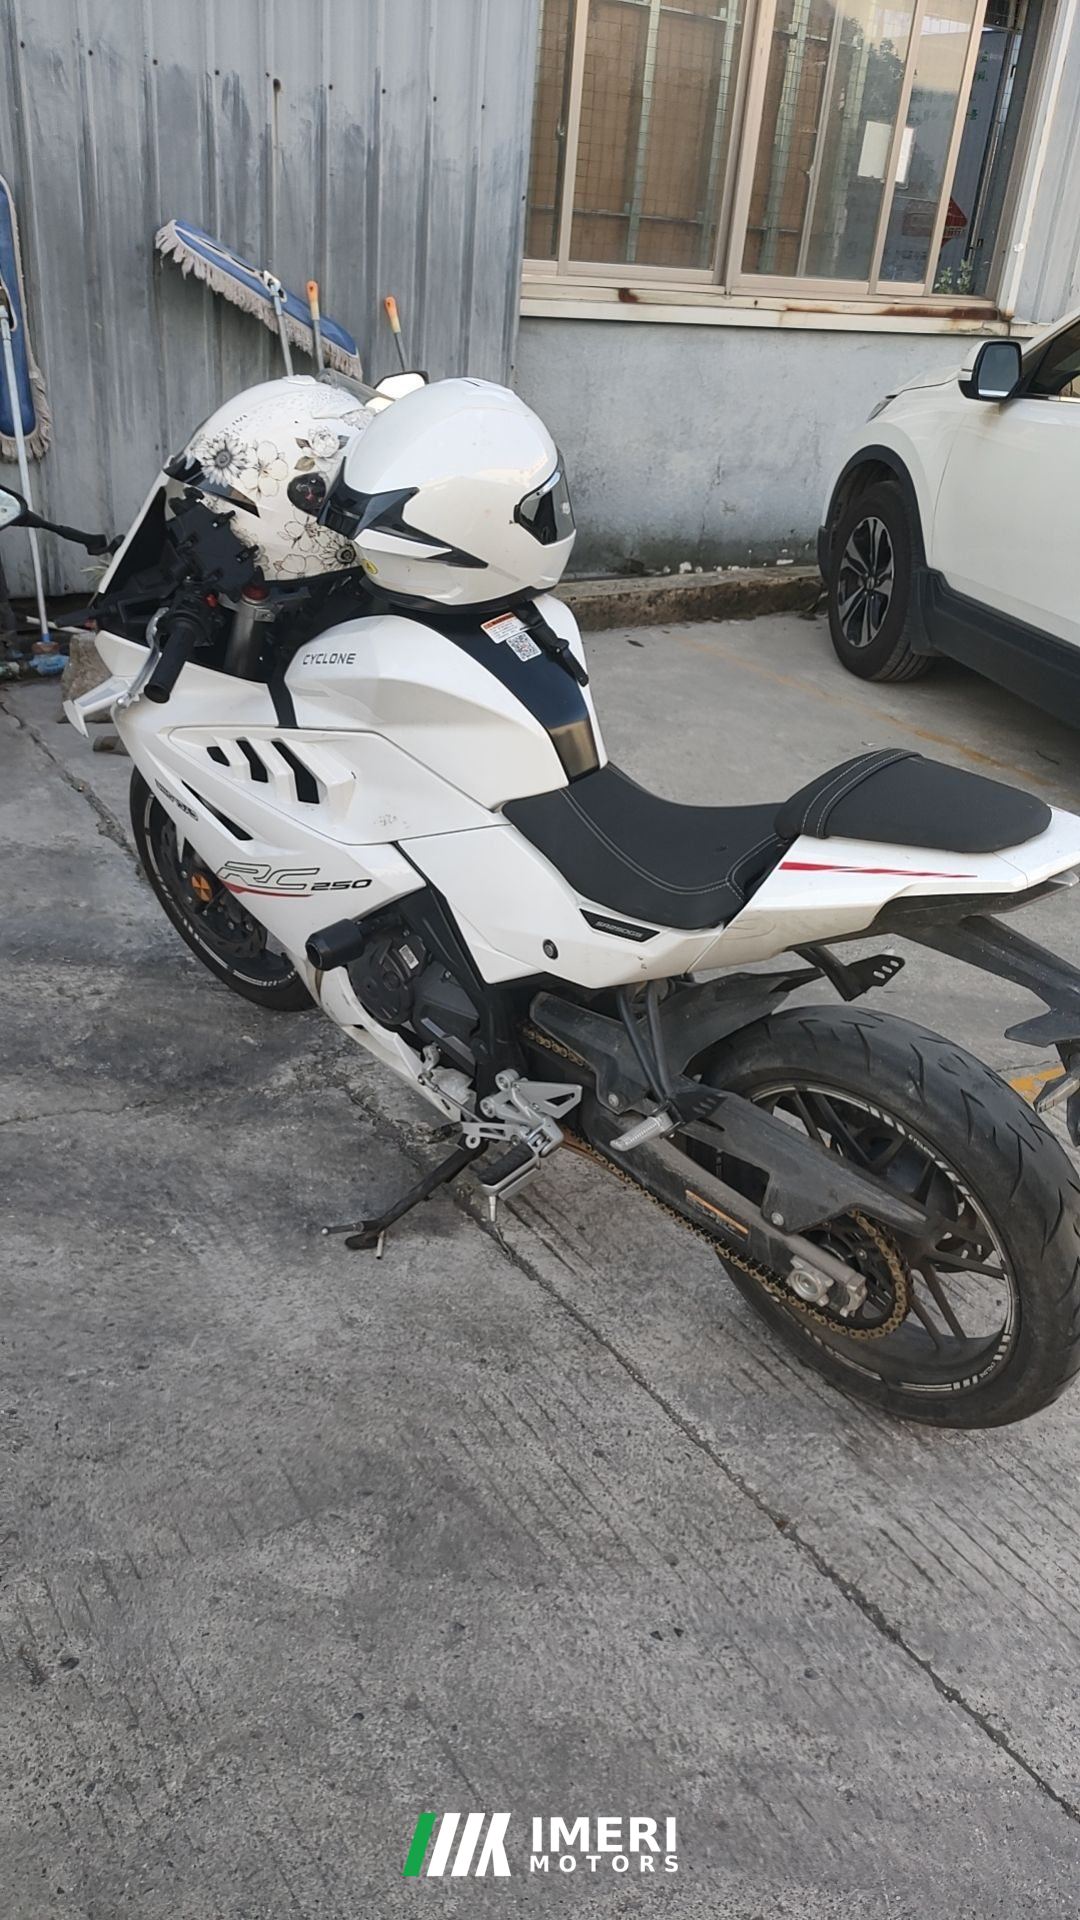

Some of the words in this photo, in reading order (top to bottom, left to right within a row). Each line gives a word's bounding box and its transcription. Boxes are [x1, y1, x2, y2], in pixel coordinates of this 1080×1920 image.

[302, 652, 357, 665] CYCLONE
[216, 860, 320, 890] RC
[311, 879, 373, 891] 250
